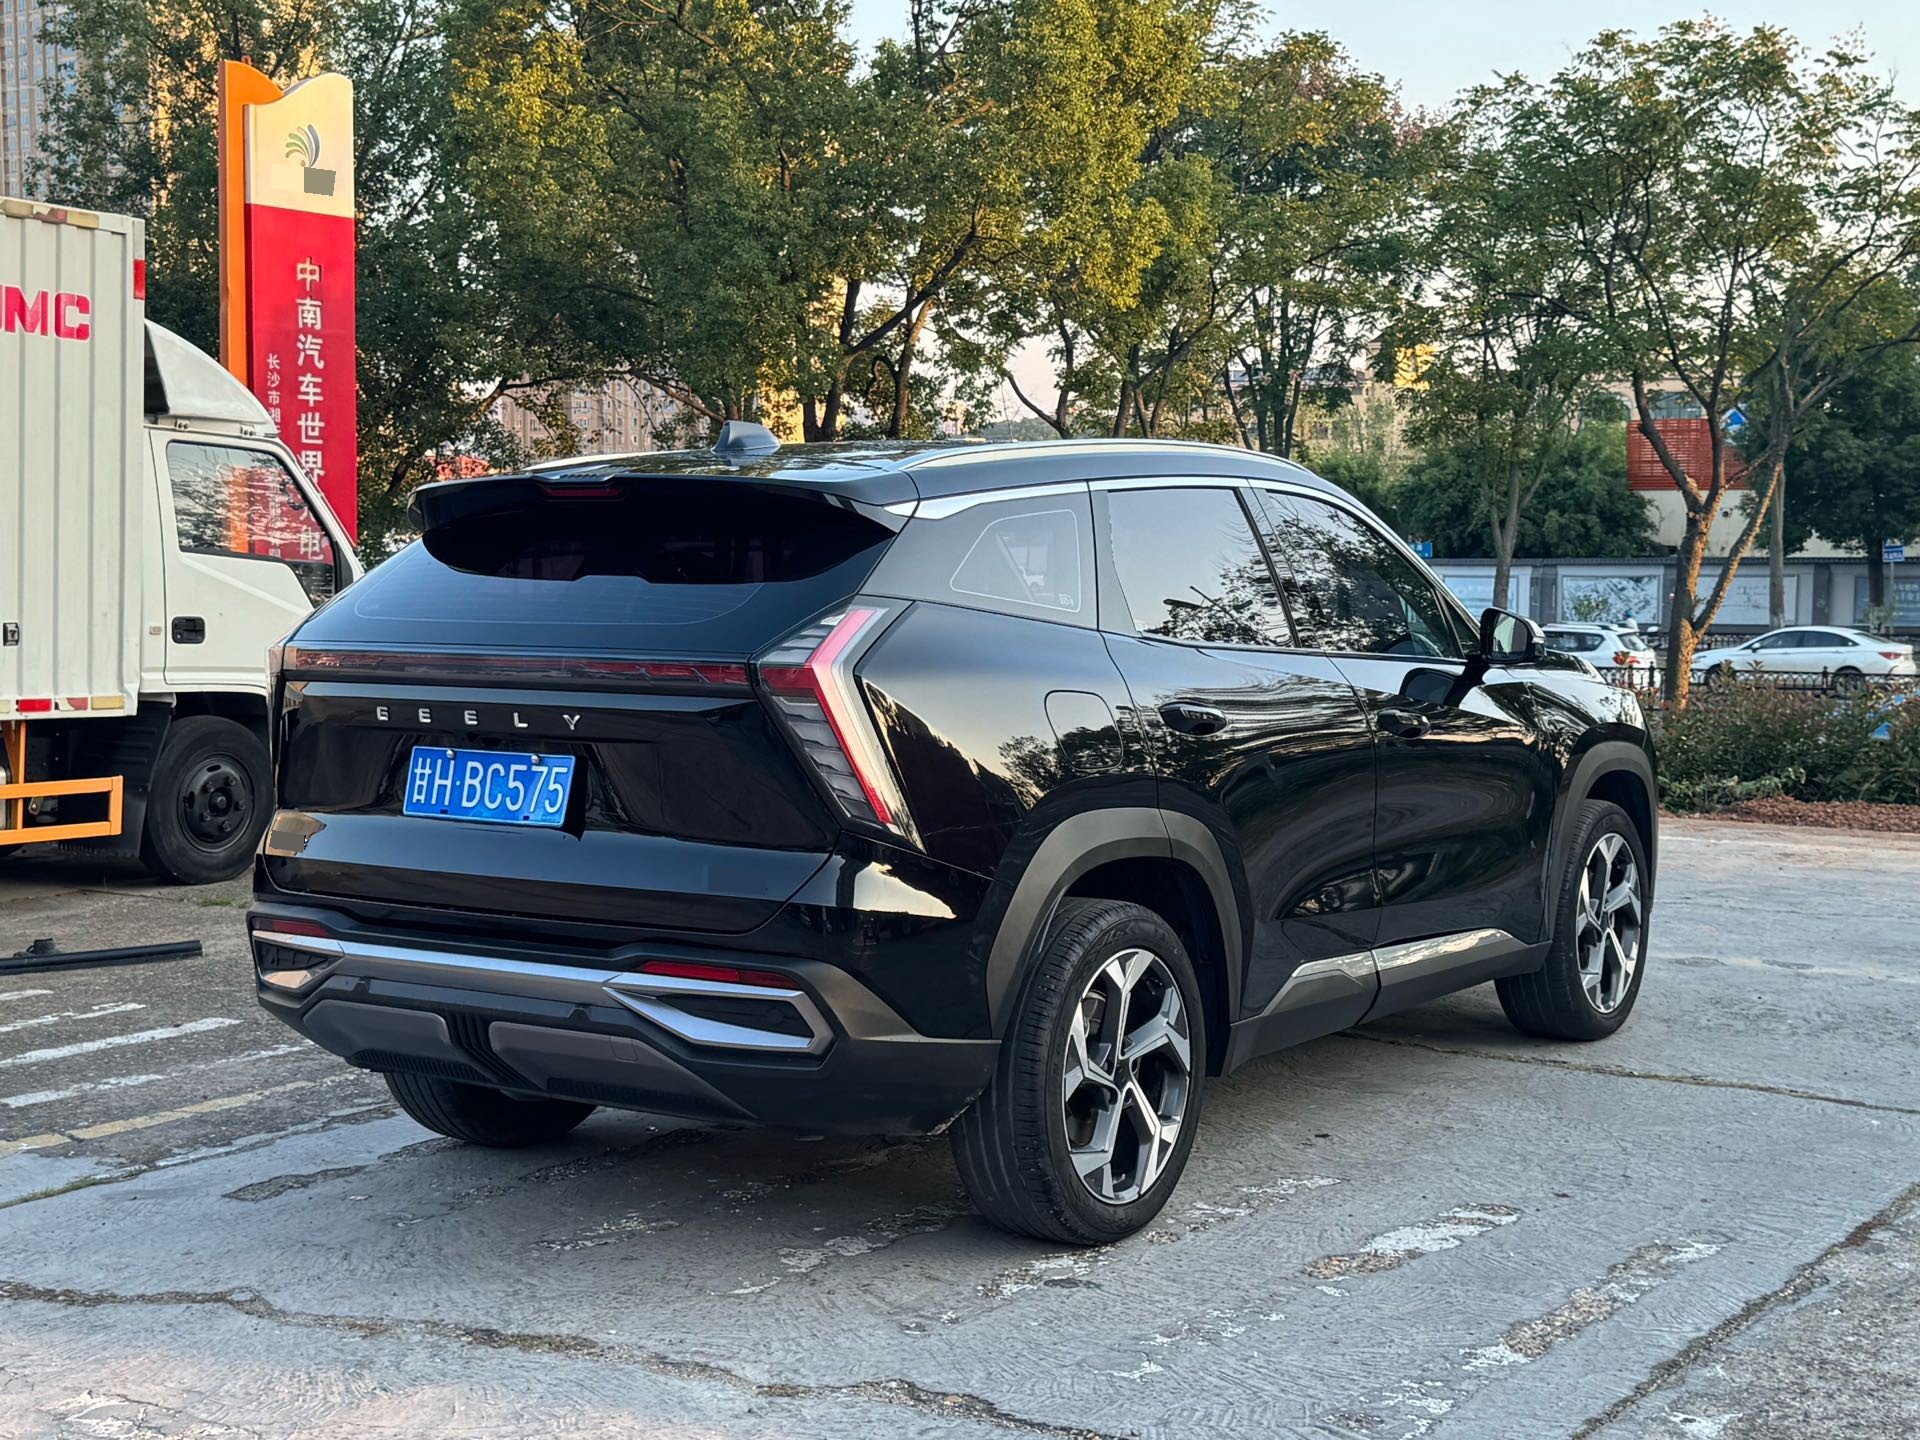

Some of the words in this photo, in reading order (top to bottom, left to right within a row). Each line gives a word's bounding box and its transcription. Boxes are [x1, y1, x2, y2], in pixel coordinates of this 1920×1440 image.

[0, 285, 91, 342] MC
[266, 353, 281, 433] 长沙市湘
[376, 706, 581, 731] GEELY
